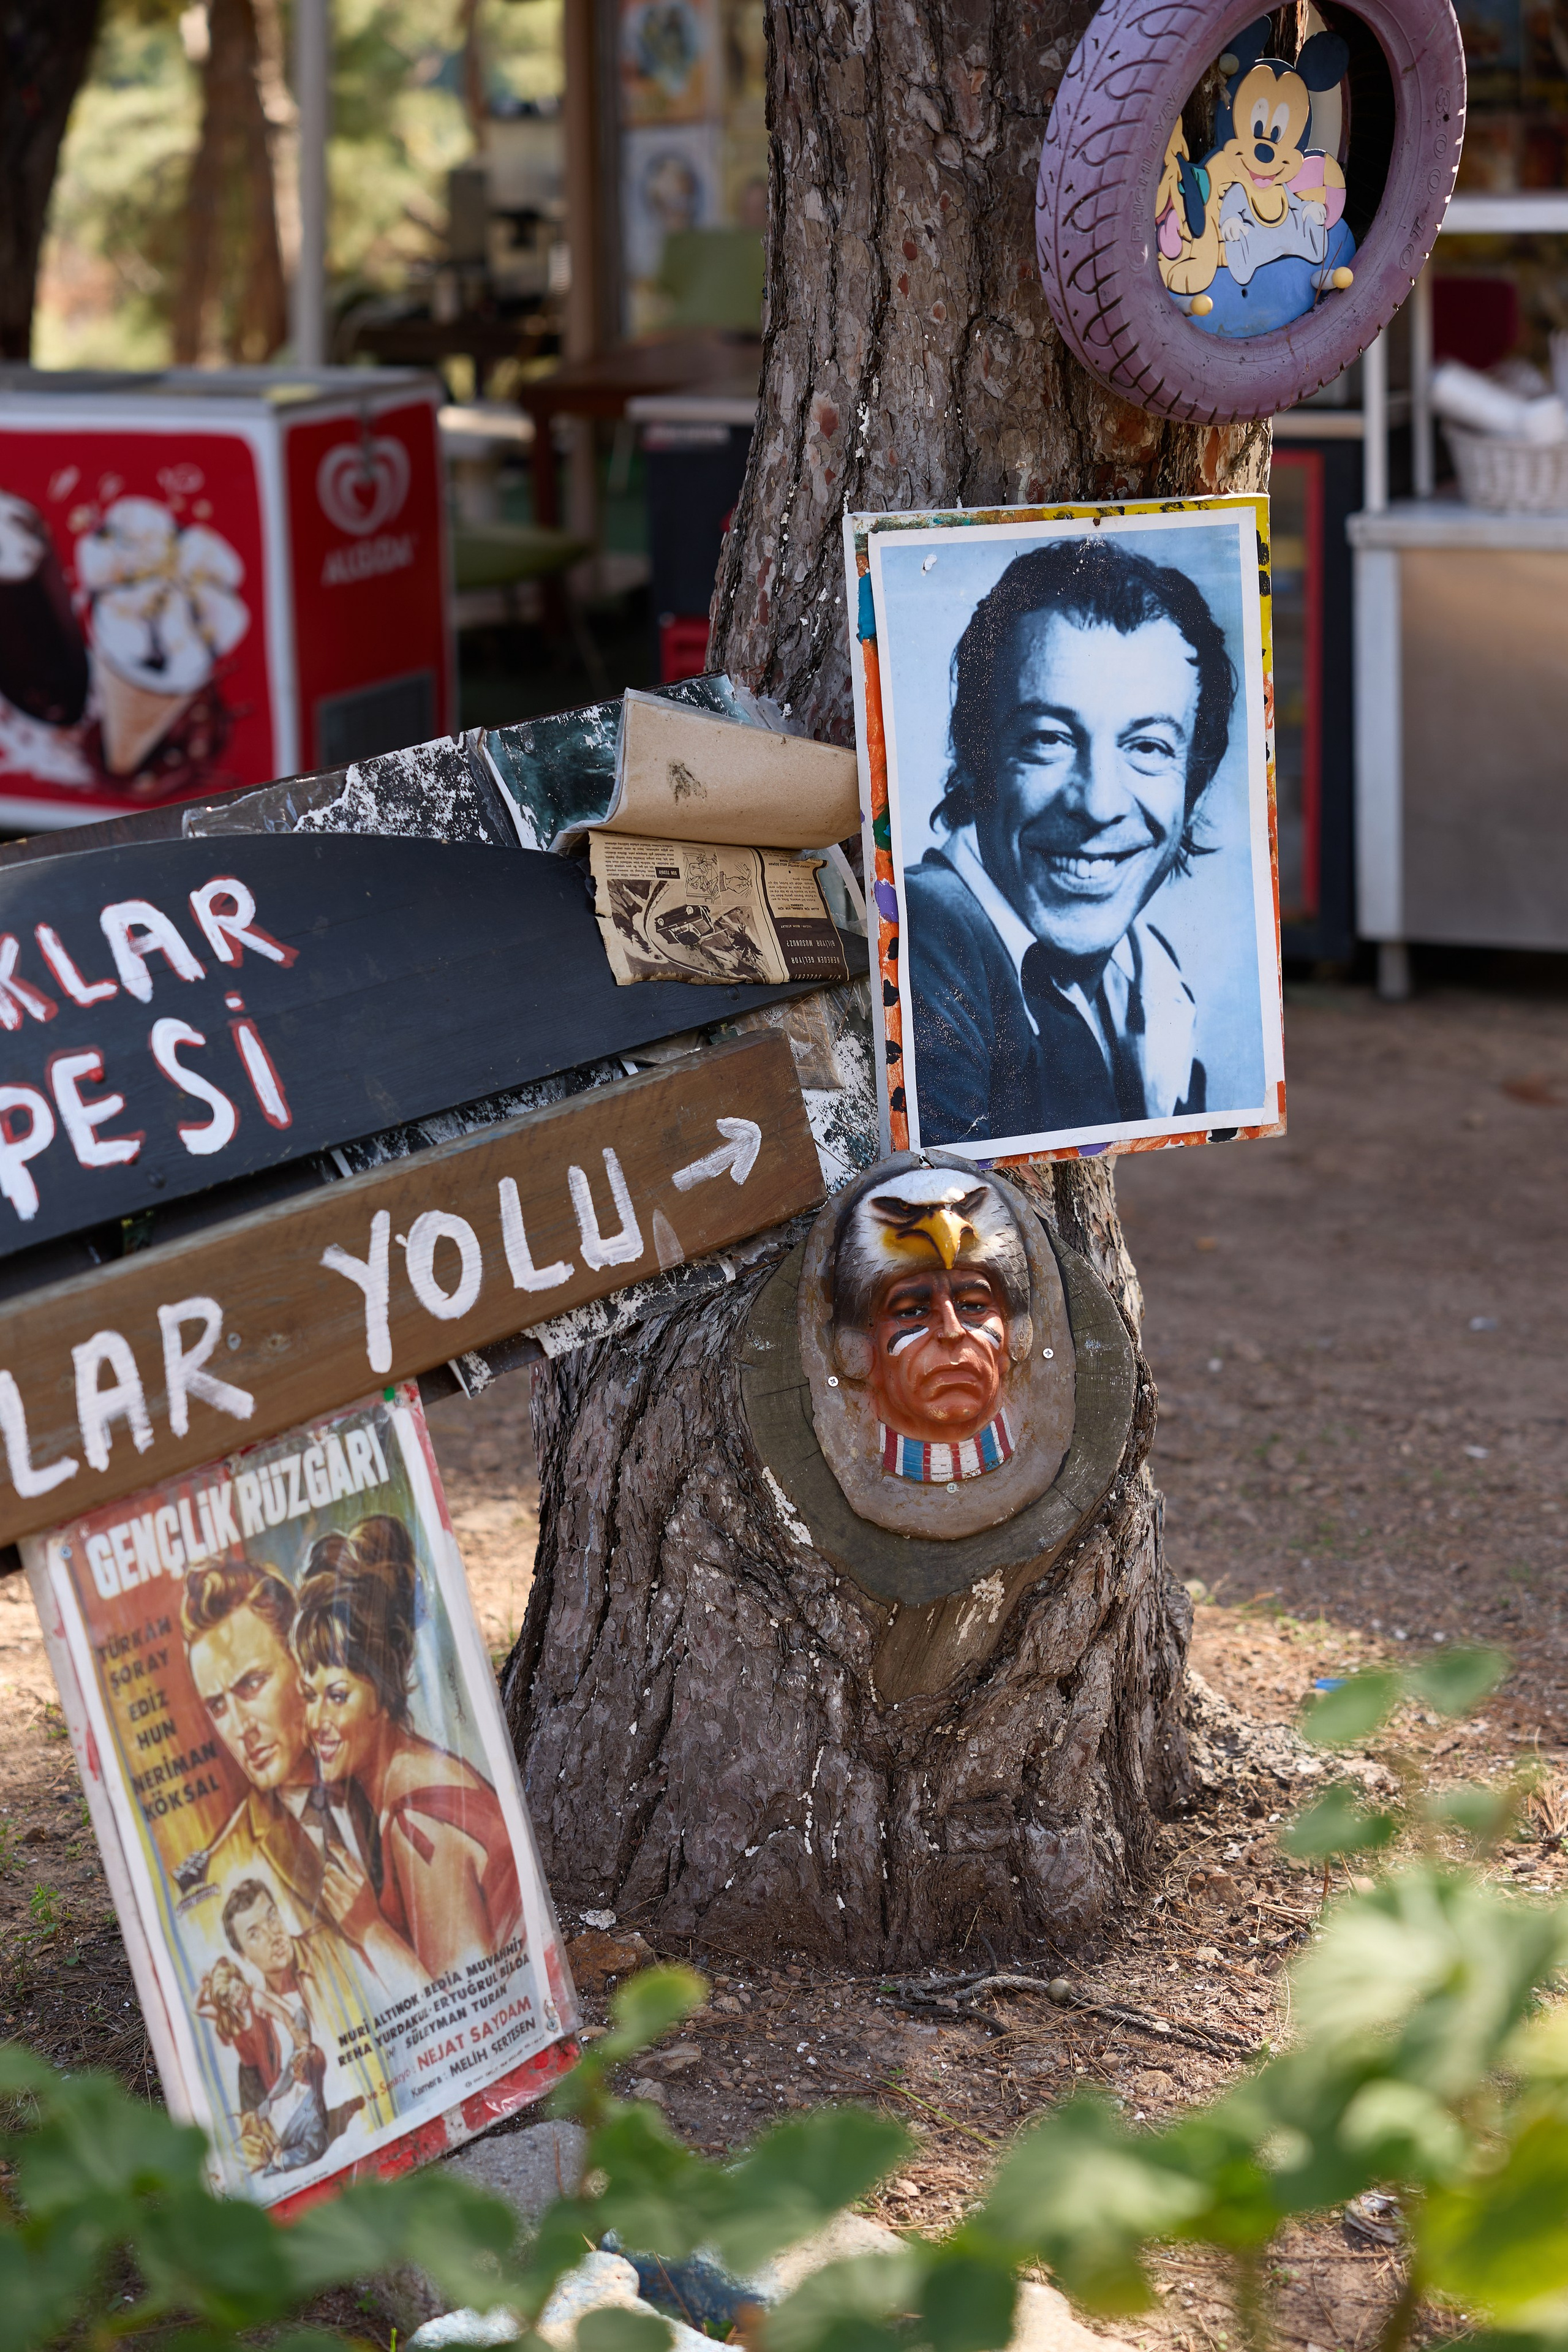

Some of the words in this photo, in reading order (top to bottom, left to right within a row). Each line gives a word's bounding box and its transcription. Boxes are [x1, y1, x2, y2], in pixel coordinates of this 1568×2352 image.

[320, 1147, 644, 1374] YOLU
[85, 1480, 241, 1600] GENÇLİK
[137, 1717, 178, 1751] HUN
[145, 1775, 221, 1821] KÖKSAL
[337, 2043, 372, 2067] REHA
[375, 2010, 430, 2048] YURDAKUL
[433, 1975, 499, 2013] ERTUĞRUL
[374, 1992, 420, 2030] ALTINOK
[424, 1970, 462, 1999] BEDİA
[405, 2006, 467, 2049] SÜLEYMAN
[472, 1983, 508, 2013] TURAN
[416, 2034, 465, 2071] NEJAT
[469, 1995, 532, 2044] SAYDAM
[449, 2049, 489, 2078] MELİH
